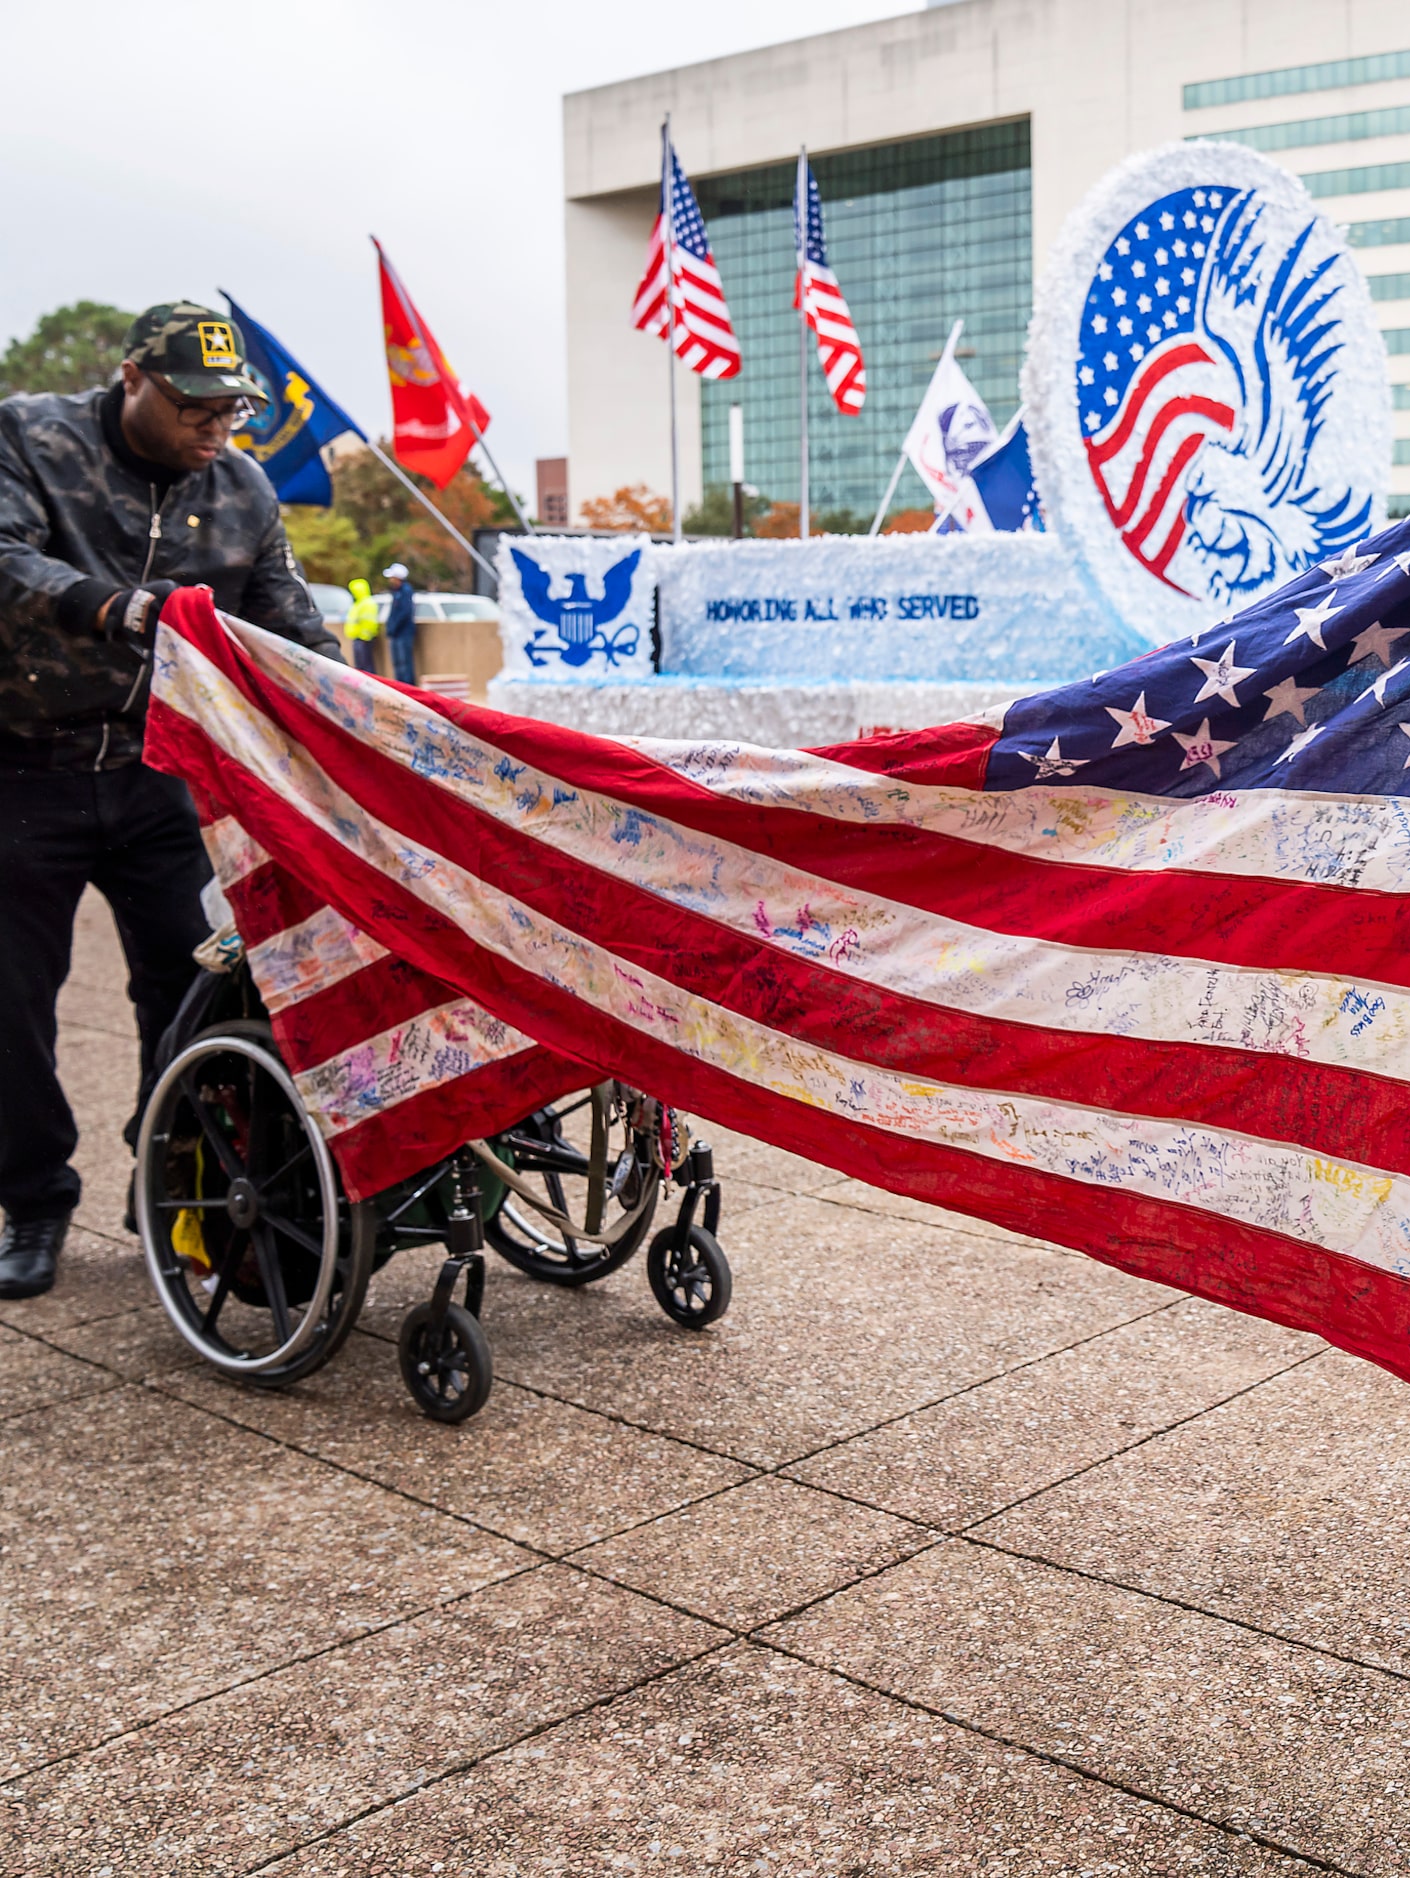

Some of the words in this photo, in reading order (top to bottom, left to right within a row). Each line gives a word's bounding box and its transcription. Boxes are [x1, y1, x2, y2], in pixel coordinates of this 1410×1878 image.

[706, 600, 797, 623] HONORING
[804, 600, 838, 622] ALL
[898, 594, 980, 621] SERVED
